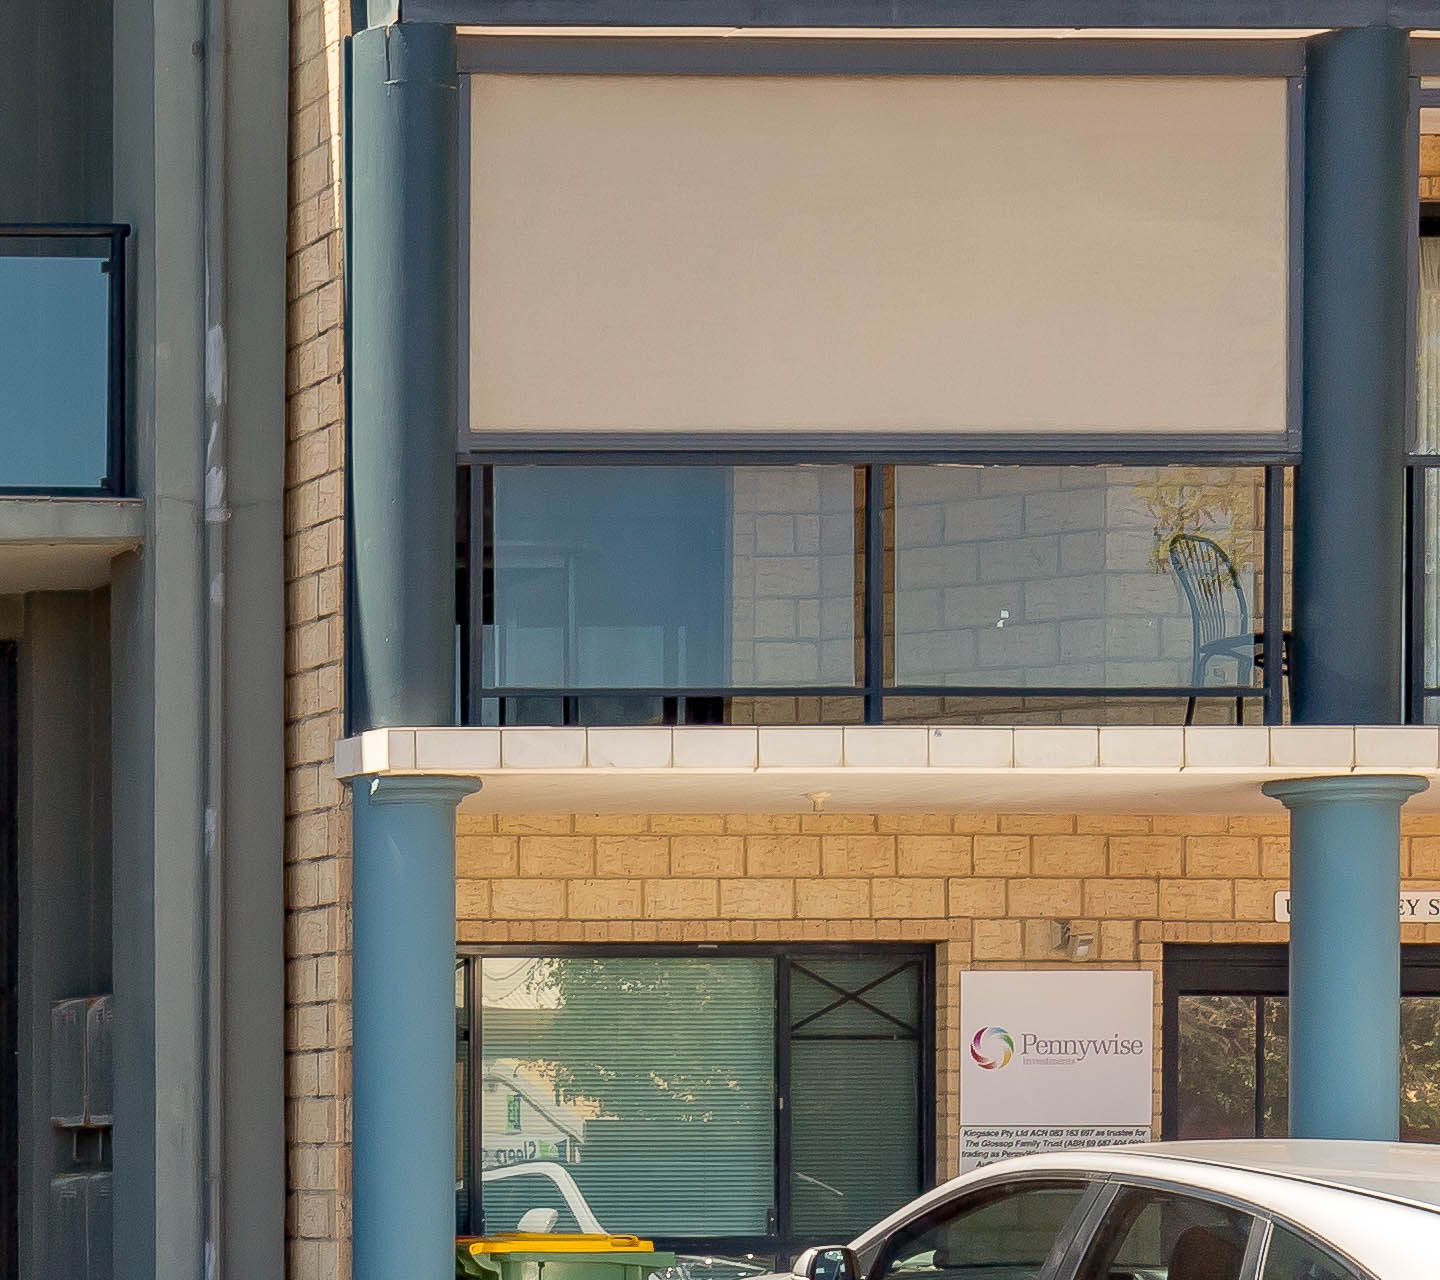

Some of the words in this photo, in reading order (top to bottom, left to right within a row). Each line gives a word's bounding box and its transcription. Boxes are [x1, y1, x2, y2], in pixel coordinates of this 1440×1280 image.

[1021, 1033, 1144, 1062] Pennywise
[1001, 1129, 1014, 1139] Pty
[1015, 1129, 1028, 1137] Ltd
[1030, 1129, 1048, 1137] ACN
[1134, 1128, 1147, 1137] for
[965, 1139, 980, 1148] The
[1015, 1139, 1041, 1149] Family
[1043, 1139, 1063, 1148] Trust
[961, 1150, 989, 1160] trading
